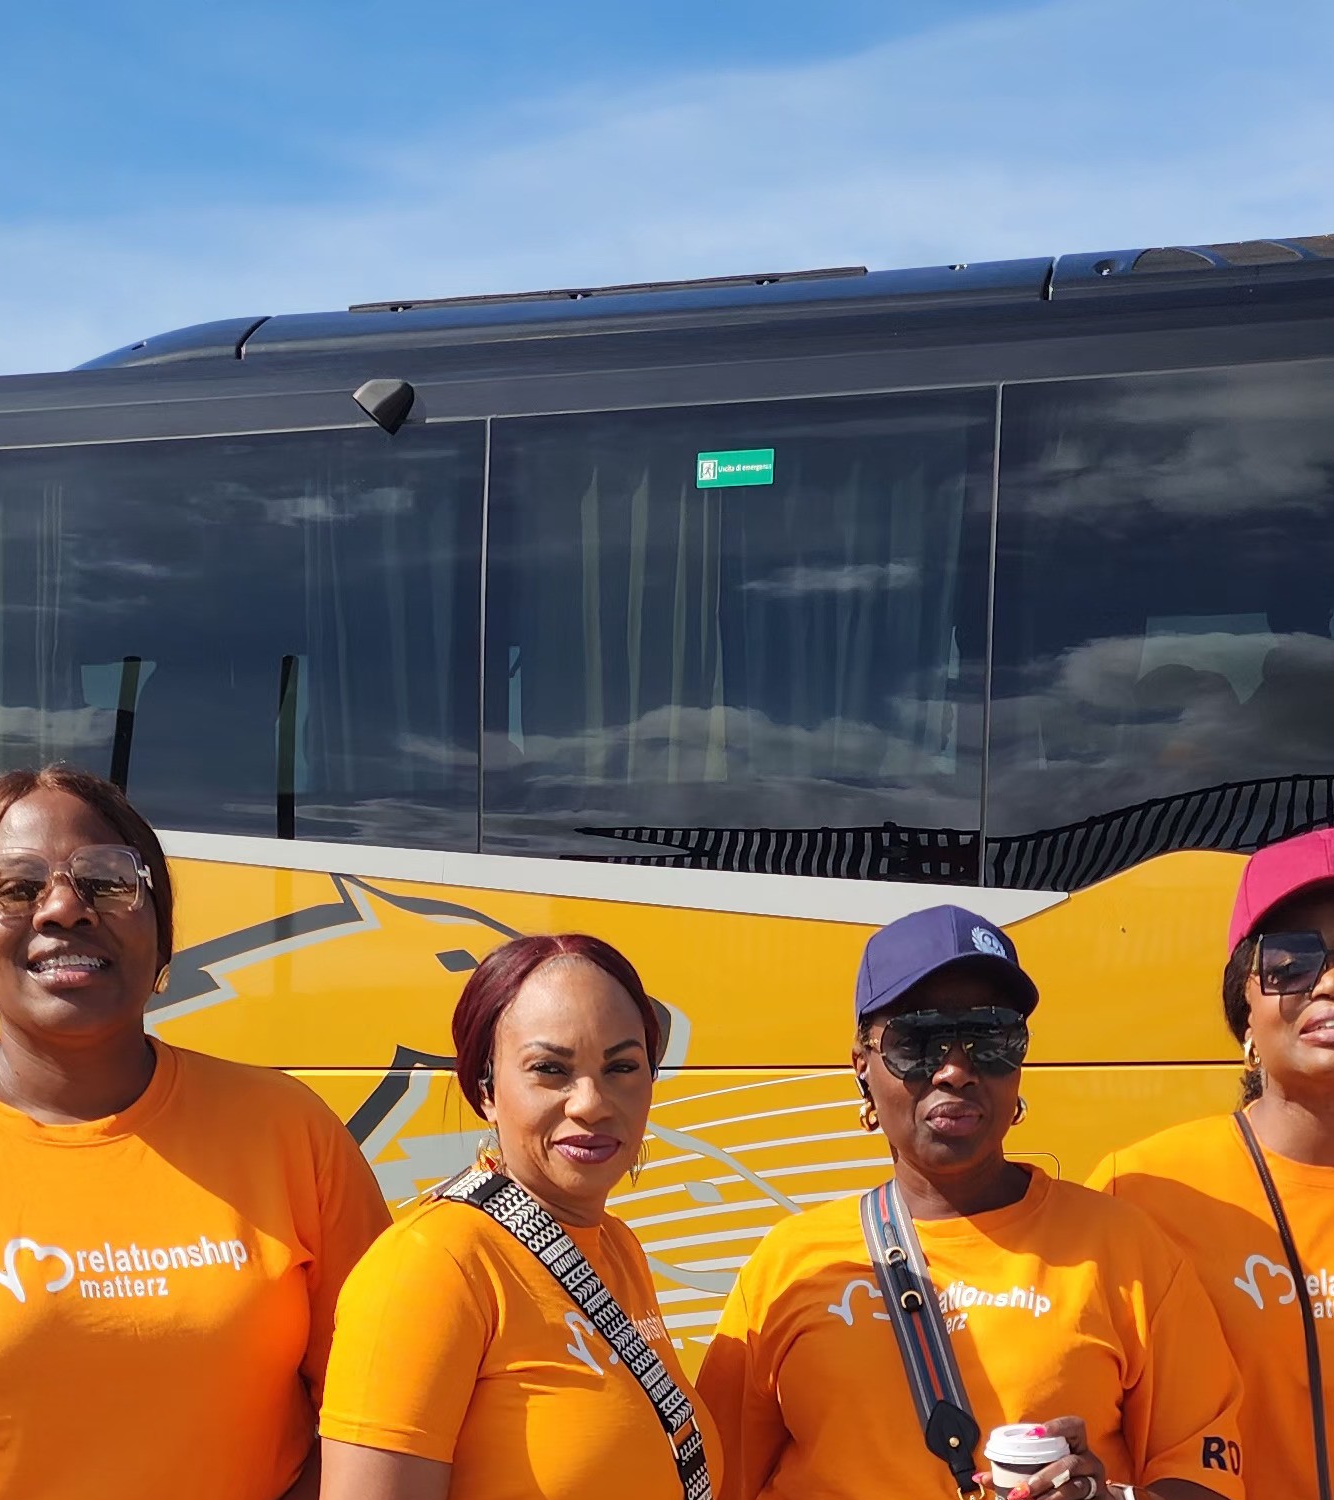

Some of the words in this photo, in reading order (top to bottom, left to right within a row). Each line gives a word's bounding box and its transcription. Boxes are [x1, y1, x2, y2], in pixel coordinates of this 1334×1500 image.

[76, 1236, 249, 1272] relationship
[79, 1276, 169, 1299] matterz
[938, 1280, 1052, 1318] ationship
